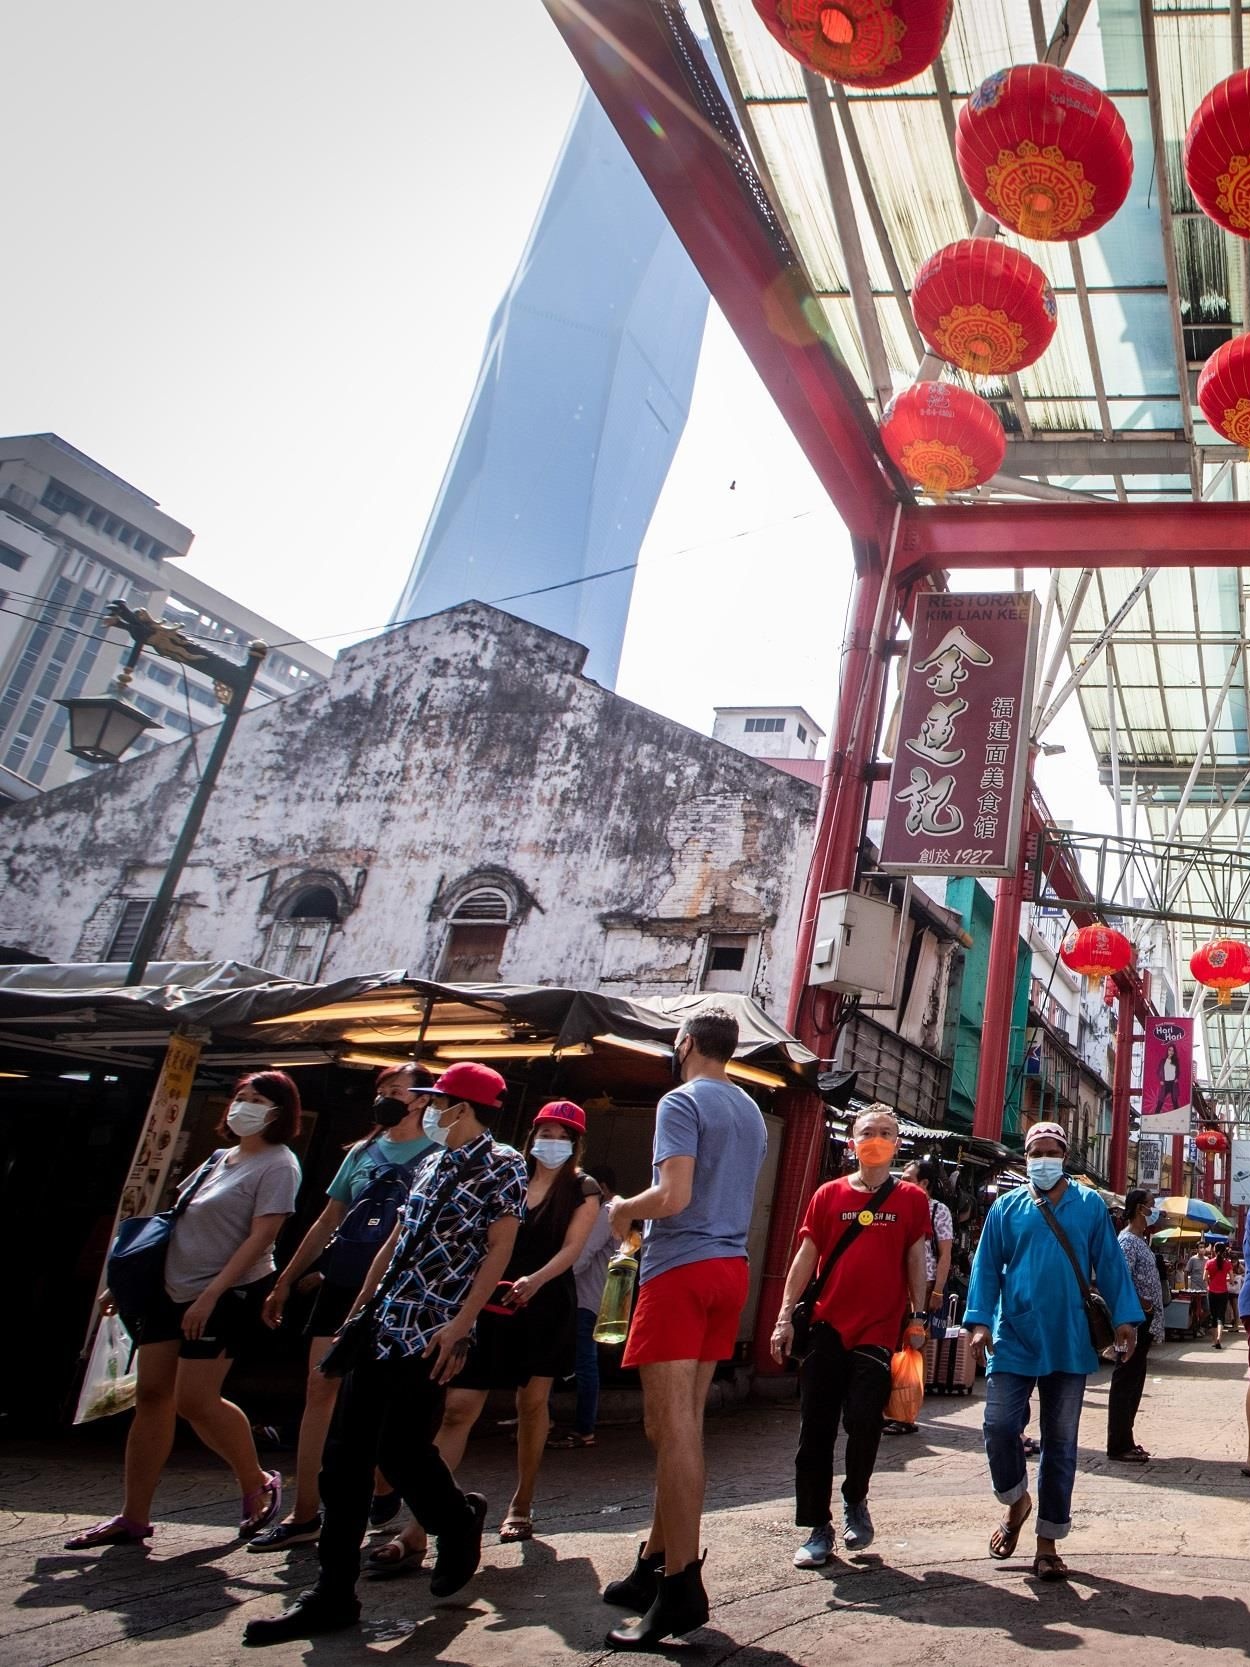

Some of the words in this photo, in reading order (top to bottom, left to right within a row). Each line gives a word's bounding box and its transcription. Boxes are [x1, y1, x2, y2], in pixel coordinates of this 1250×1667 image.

[928, 594, 1029, 608] RESTORAN
[926, 610, 953, 621] KIM
[957, 610, 993, 621] LIAN
[997, 609, 1028, 621] KEE
[973, 696, 1015, 840] 福建面美食馆
[953, 848, 993, 865] 1927
[1156, 1026, 1173, 1035] Hari
[1165, 1032, 1182, 1041] Hari
[842, 1211, 859, 1221] DON
[885, 1213, 897, 1221] ME
